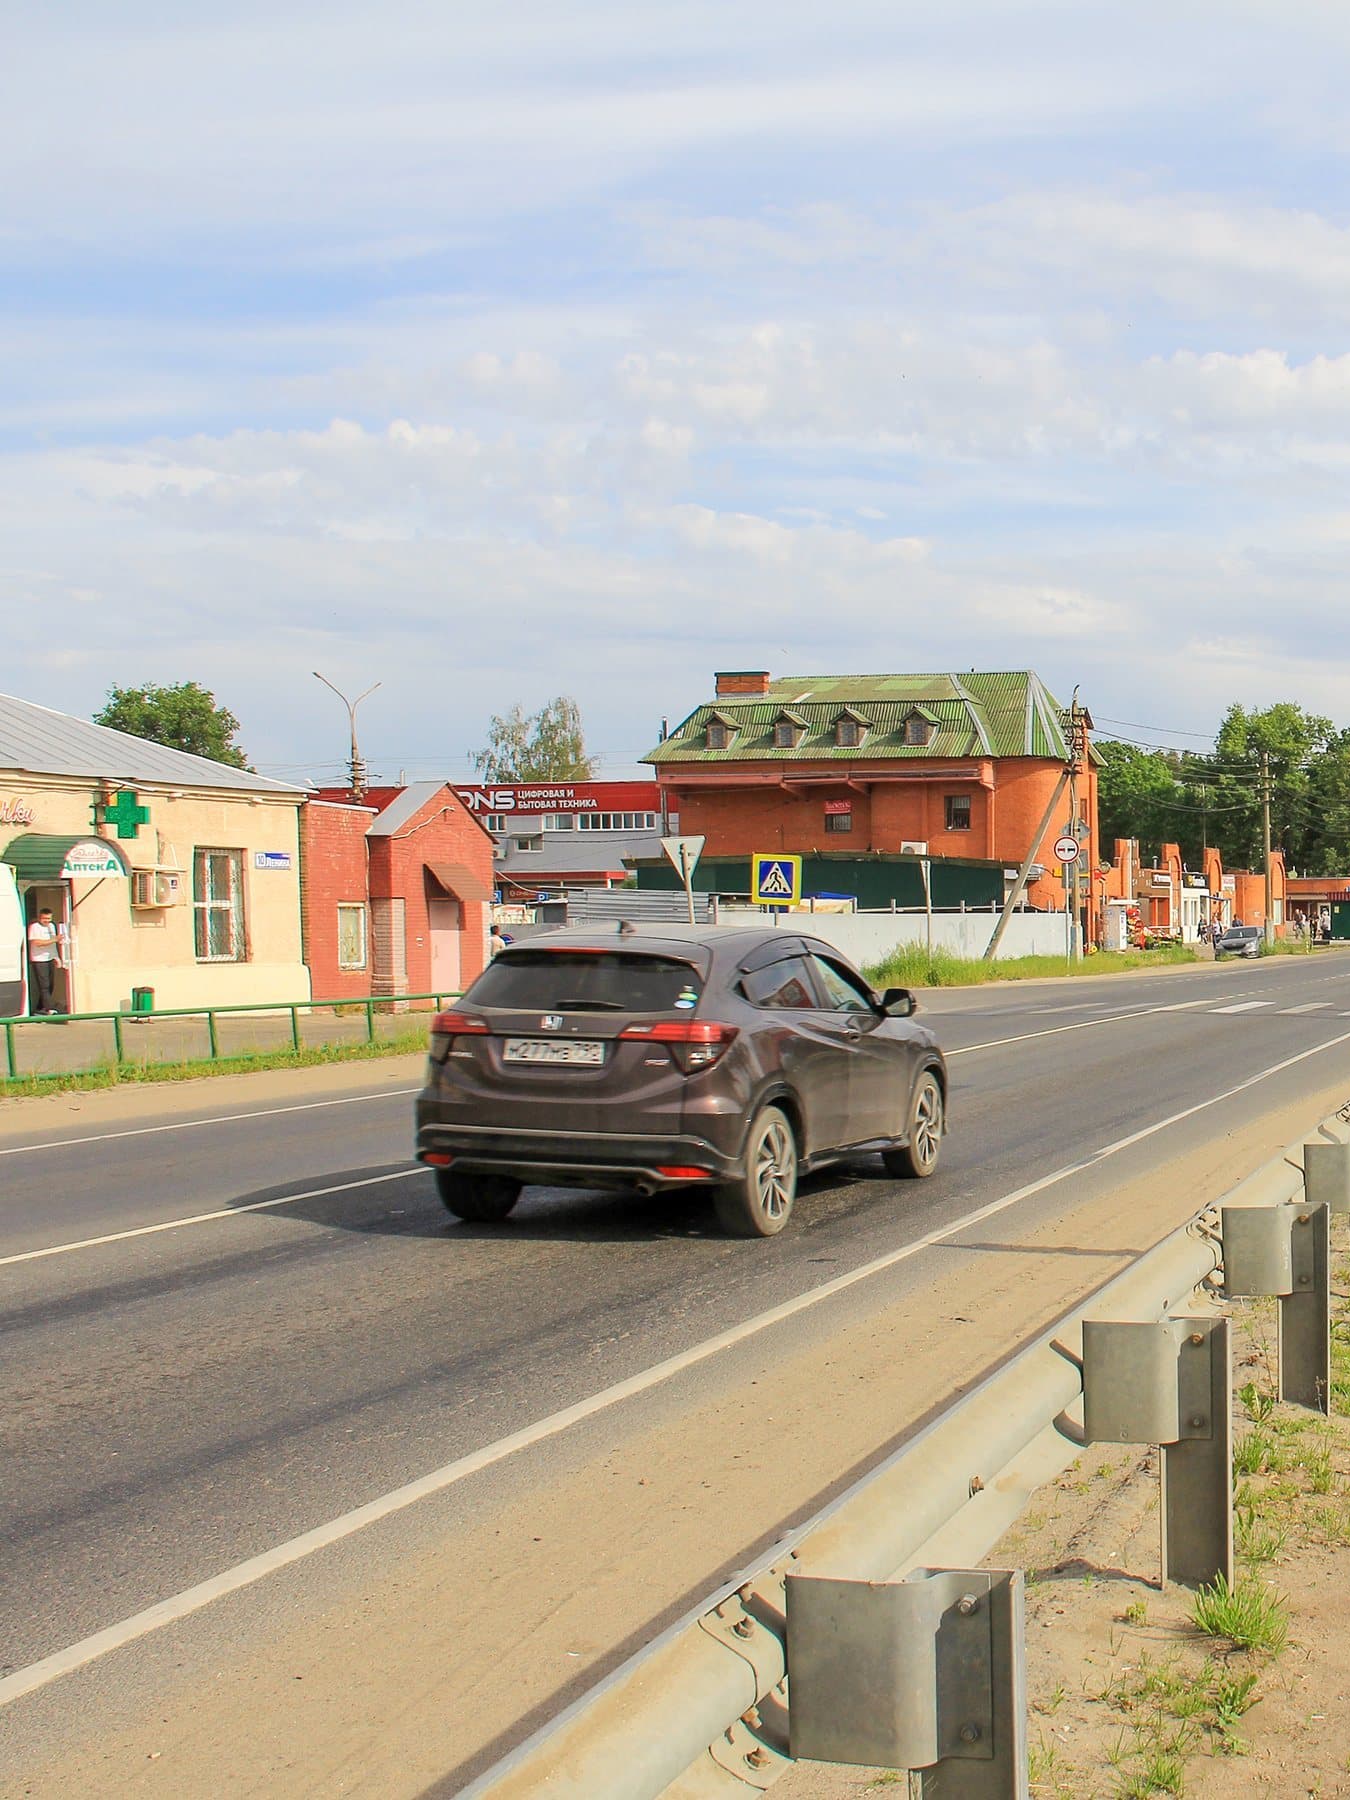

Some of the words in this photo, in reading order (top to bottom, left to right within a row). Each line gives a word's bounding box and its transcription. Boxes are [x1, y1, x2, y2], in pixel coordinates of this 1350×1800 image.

[517, 789, 565, 799] ЦИФРОВАЯ
[567, 788, 574, 797] И
[460, 790, 515, 810] DNS
[517, 800, 557, 809] БЫТОВАЯ
[559, 799, 597, 808] ТЕХНИКА
